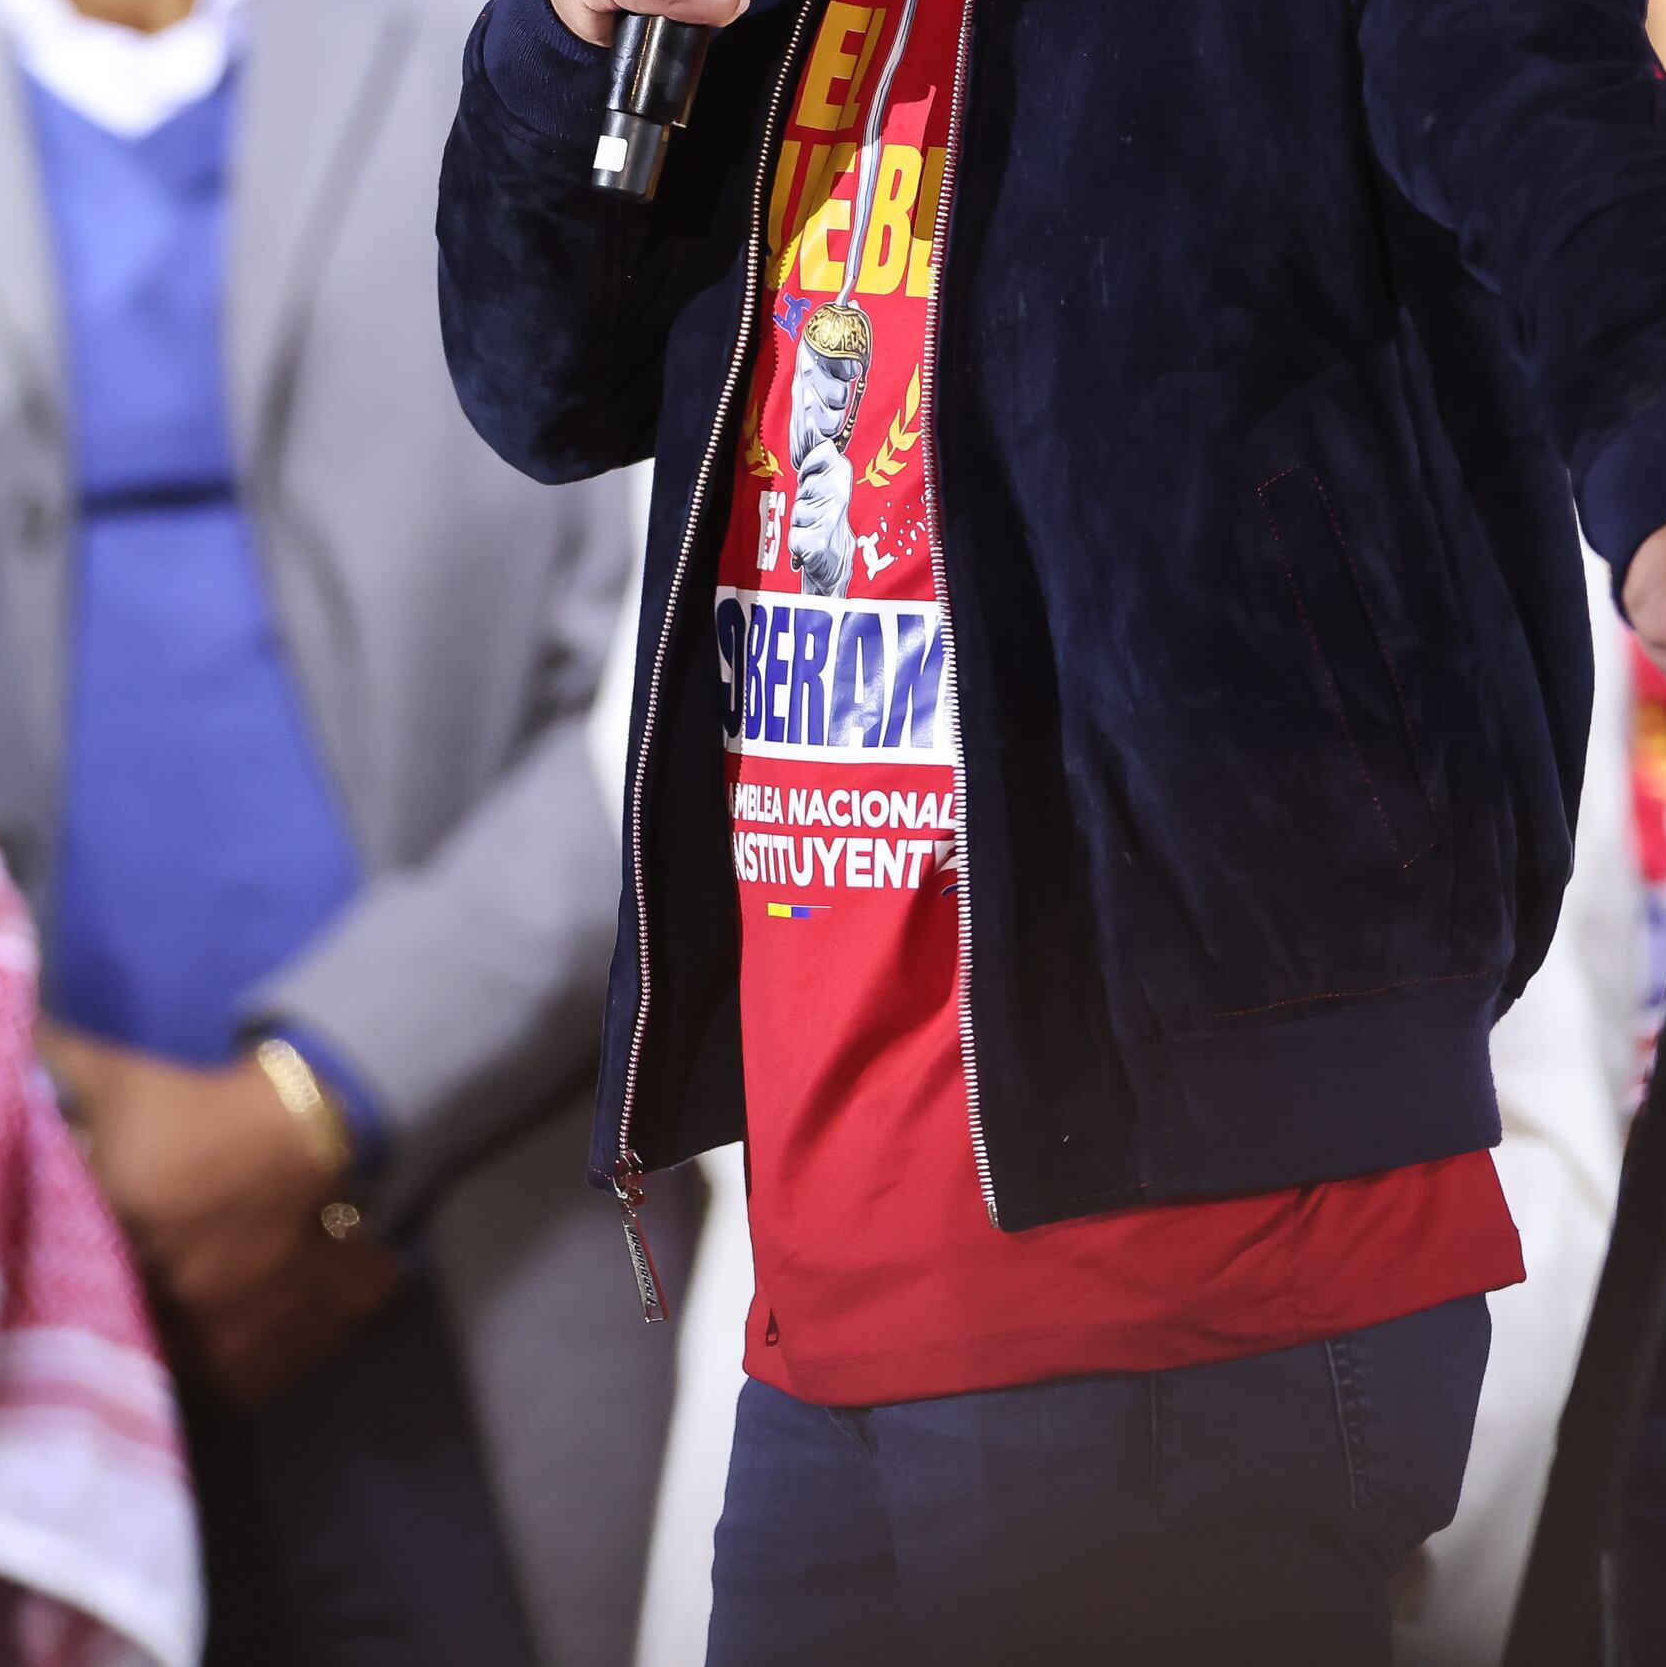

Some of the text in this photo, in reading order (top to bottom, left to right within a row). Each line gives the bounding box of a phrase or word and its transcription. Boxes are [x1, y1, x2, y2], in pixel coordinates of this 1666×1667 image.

[796, 0, 887, 132] EL
[765, 140, 949, 298] UEBL
[757, 491, 786, 572] ES
[730, 782, 962, 831] MBLEA NACIONAL
